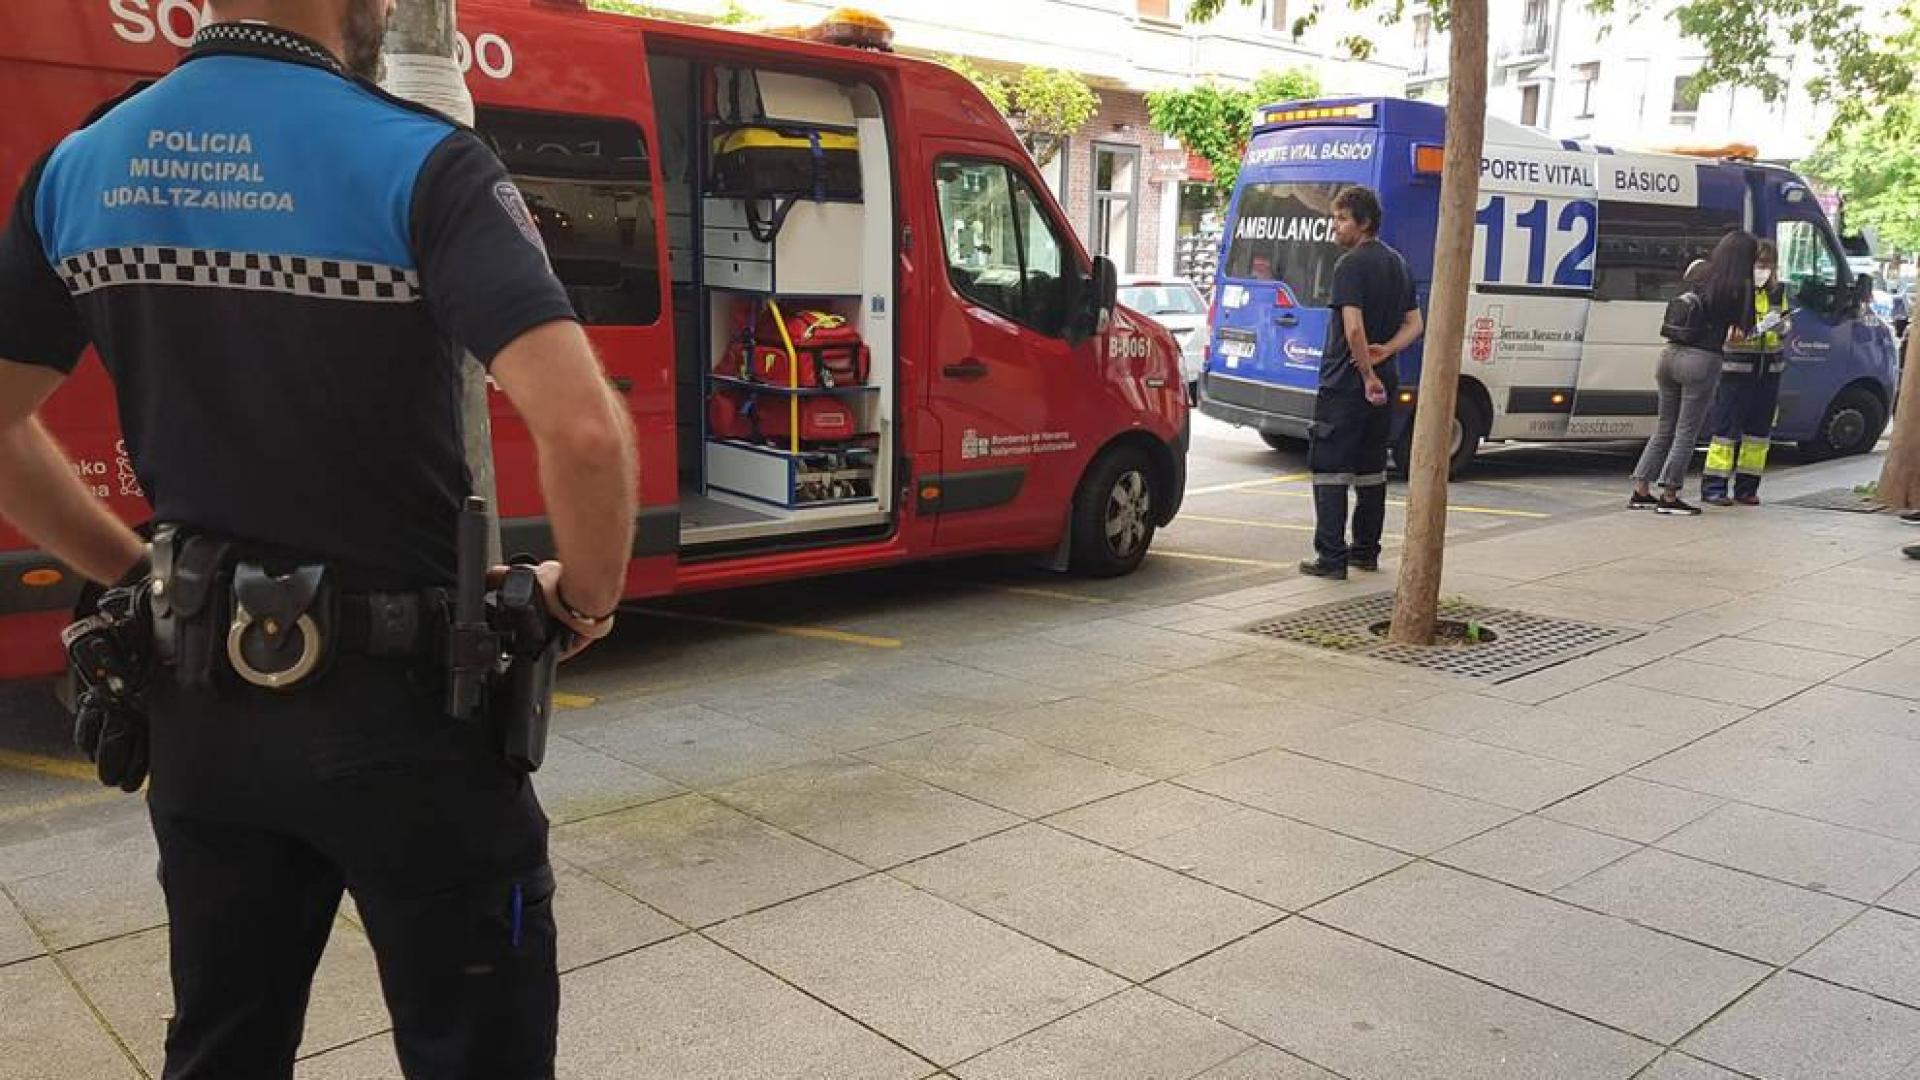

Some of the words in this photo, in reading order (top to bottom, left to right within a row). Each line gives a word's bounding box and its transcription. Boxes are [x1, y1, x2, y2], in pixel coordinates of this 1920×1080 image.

[148, 130, 252, 154] POLICIA
[1290, 143, 1318, 160] VITAL
[1321, 139, 1371, 160] BÁSICO
[129, 158, 265, 183] MUNICIPAL
[1480, 158, 1539, 183] PORTE
[1545, 164, 1593, 188] VITAL
[1615, 167, 1680, 193] BÁSICO
[103, 185, 294, 212] UDALTZAINGOA
[1475, 196, 1597, 286] 112
